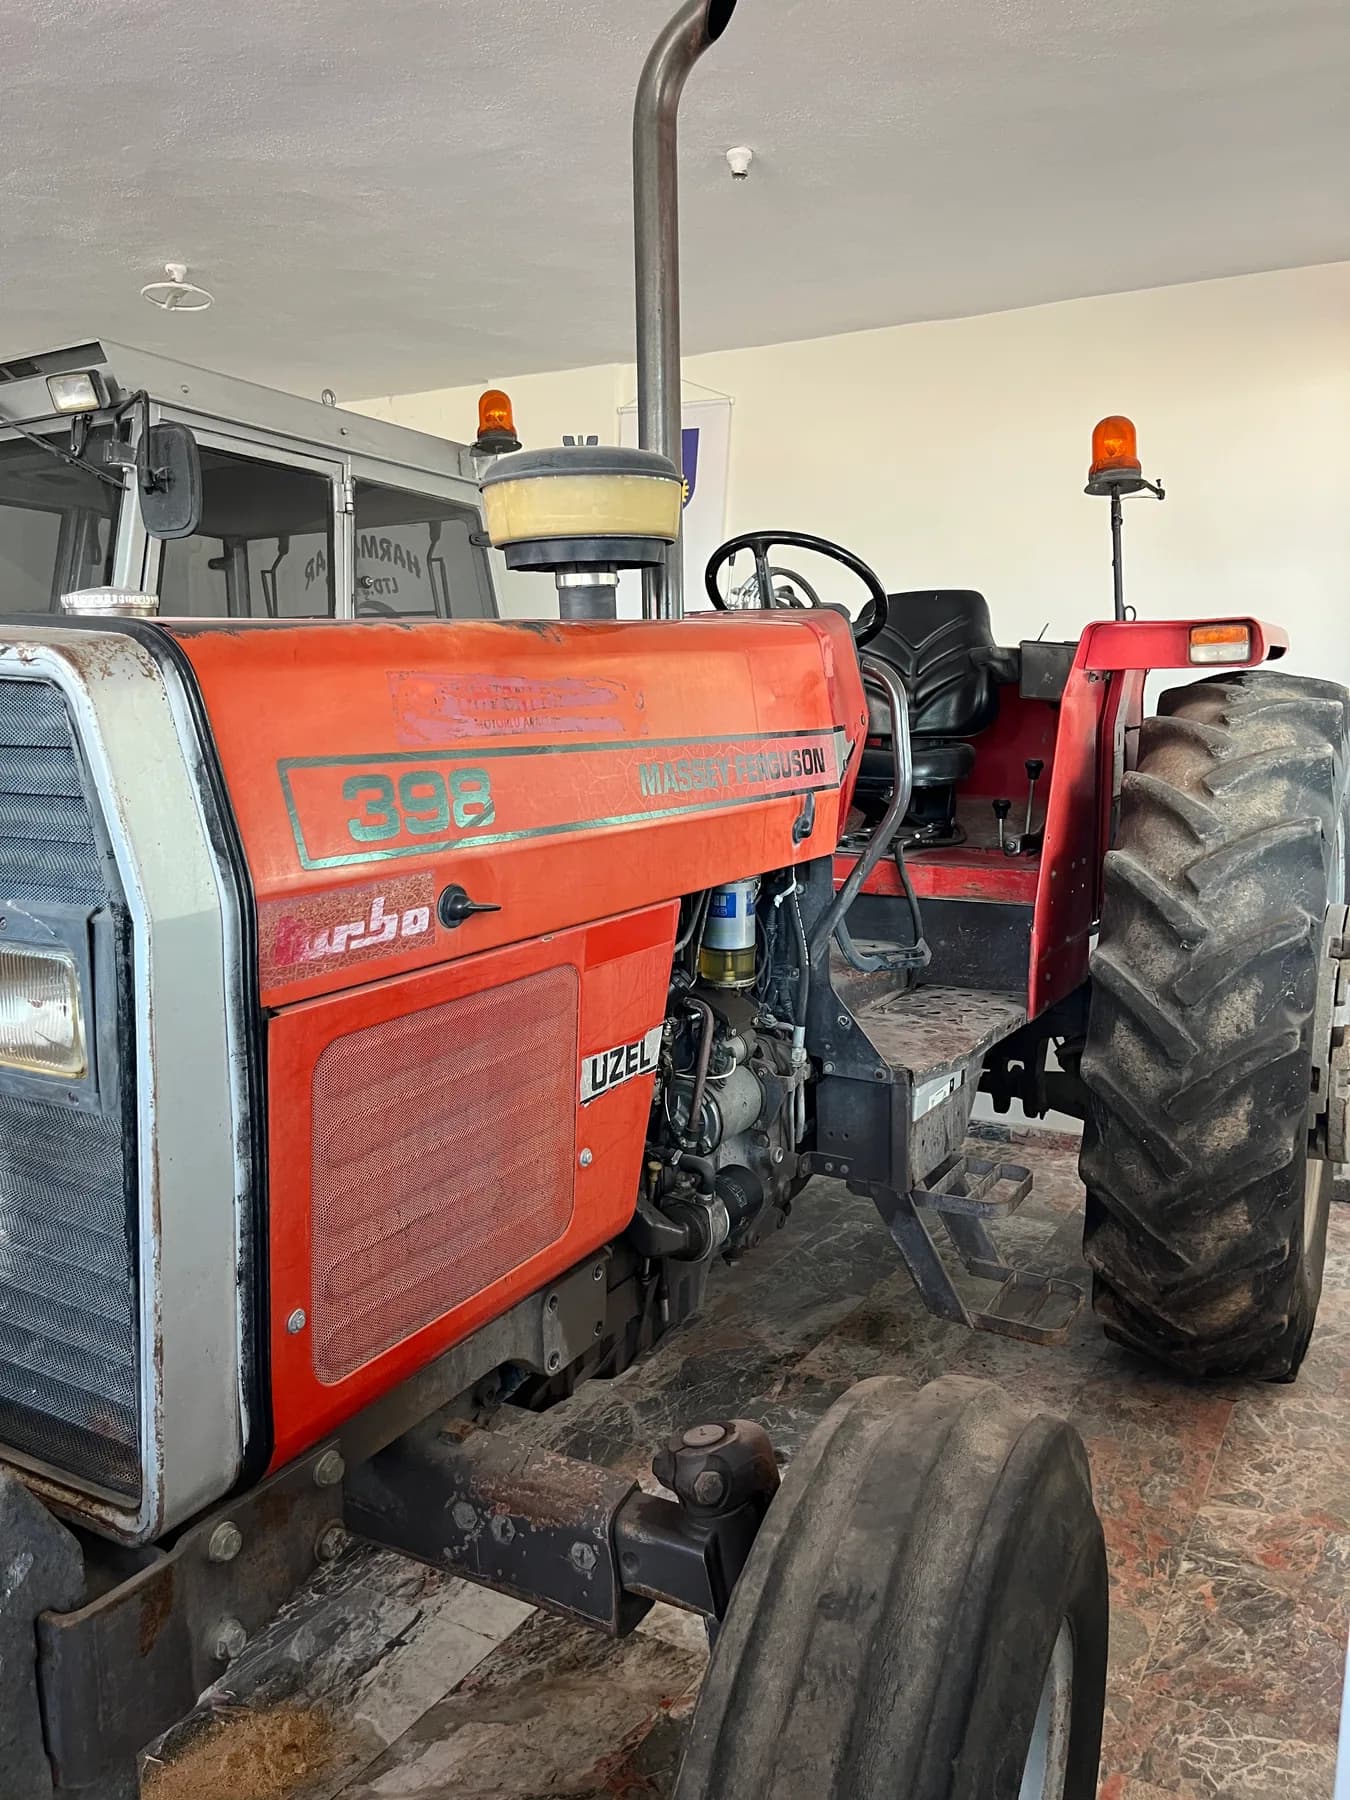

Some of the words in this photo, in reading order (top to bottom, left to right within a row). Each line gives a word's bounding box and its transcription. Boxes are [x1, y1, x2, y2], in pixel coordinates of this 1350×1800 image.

[639, 755, 729, 797] MASSEY
[735, 747, 826, 784] FERGUSON
[342, 768, 495, 842] 398
[592, 1039, 650, 1091] UZEL
